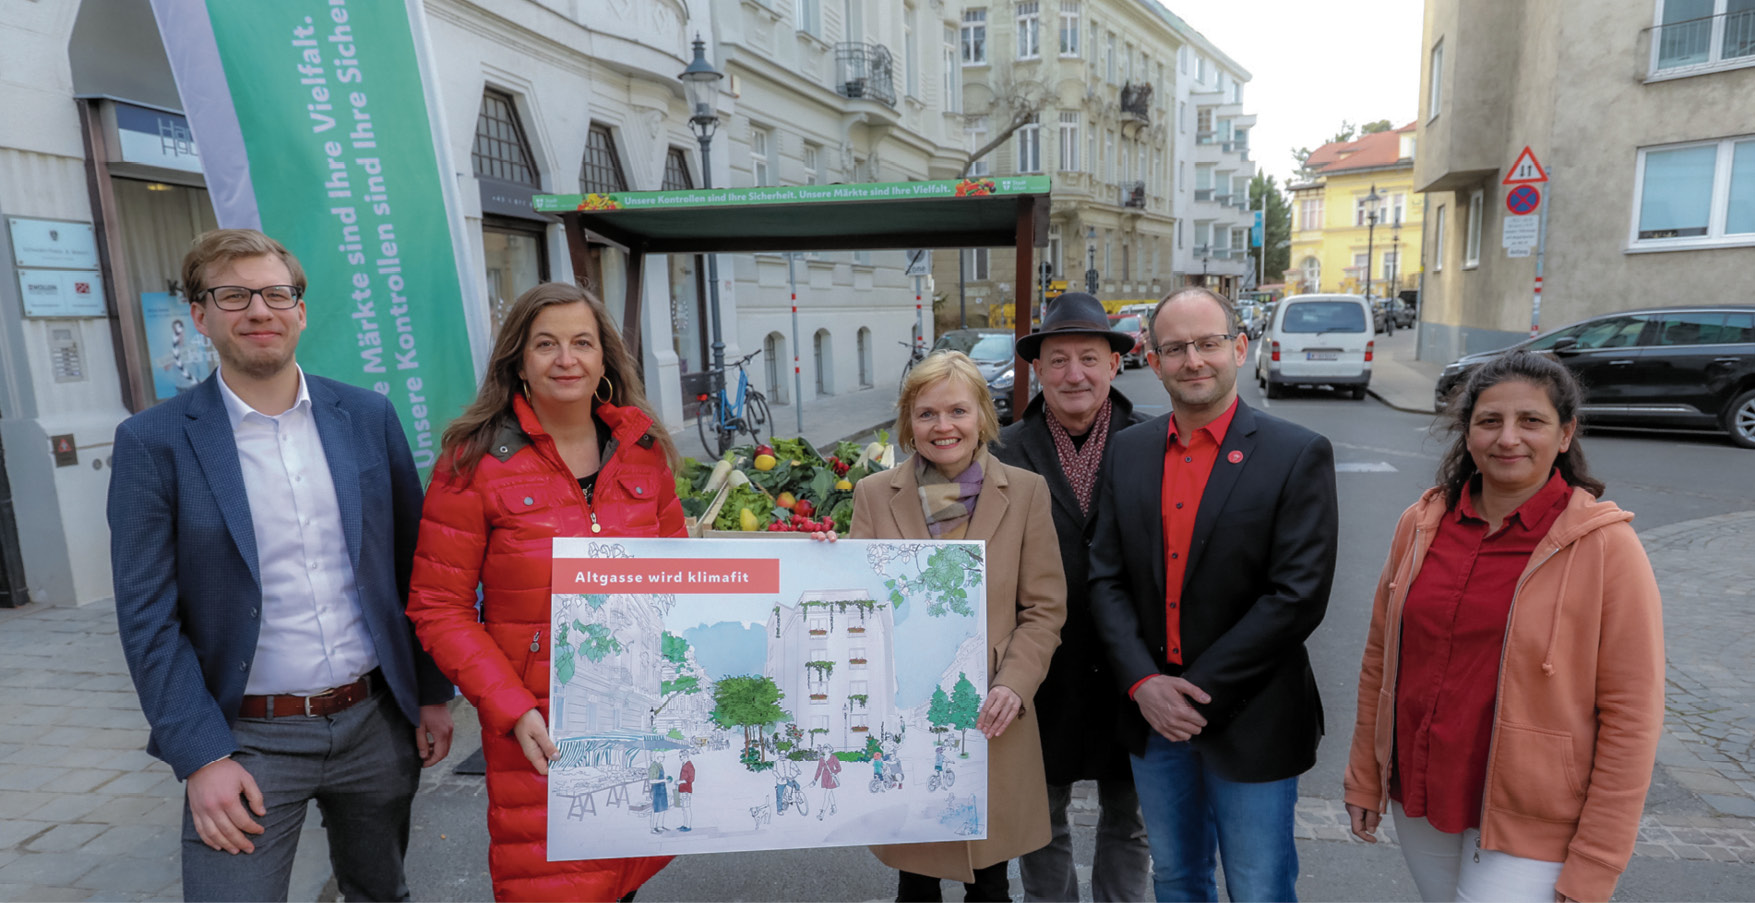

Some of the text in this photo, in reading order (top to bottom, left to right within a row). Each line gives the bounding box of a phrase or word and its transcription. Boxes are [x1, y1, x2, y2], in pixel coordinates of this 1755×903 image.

[291, 16, 336, 134] Vielfalt.
[349, 92, 376, 148] Ihre
[324, 141, 352, 198] Ihre
[355, 158, 390, 215] sind
[624, 184, 951, 206] Unsere Kontrollen sind Ihre Sicherheit. Unsere Märkte sind Ihre Vielfalt.
[331, 207, 365, 265] sind
[351, 273, 386, 373] Märkte
[376, 223, 419, 370] Kontrollen
[407, 377, 435, 469] Unsere
[574, 571, 750, 586] Altgasse wird klimafit
